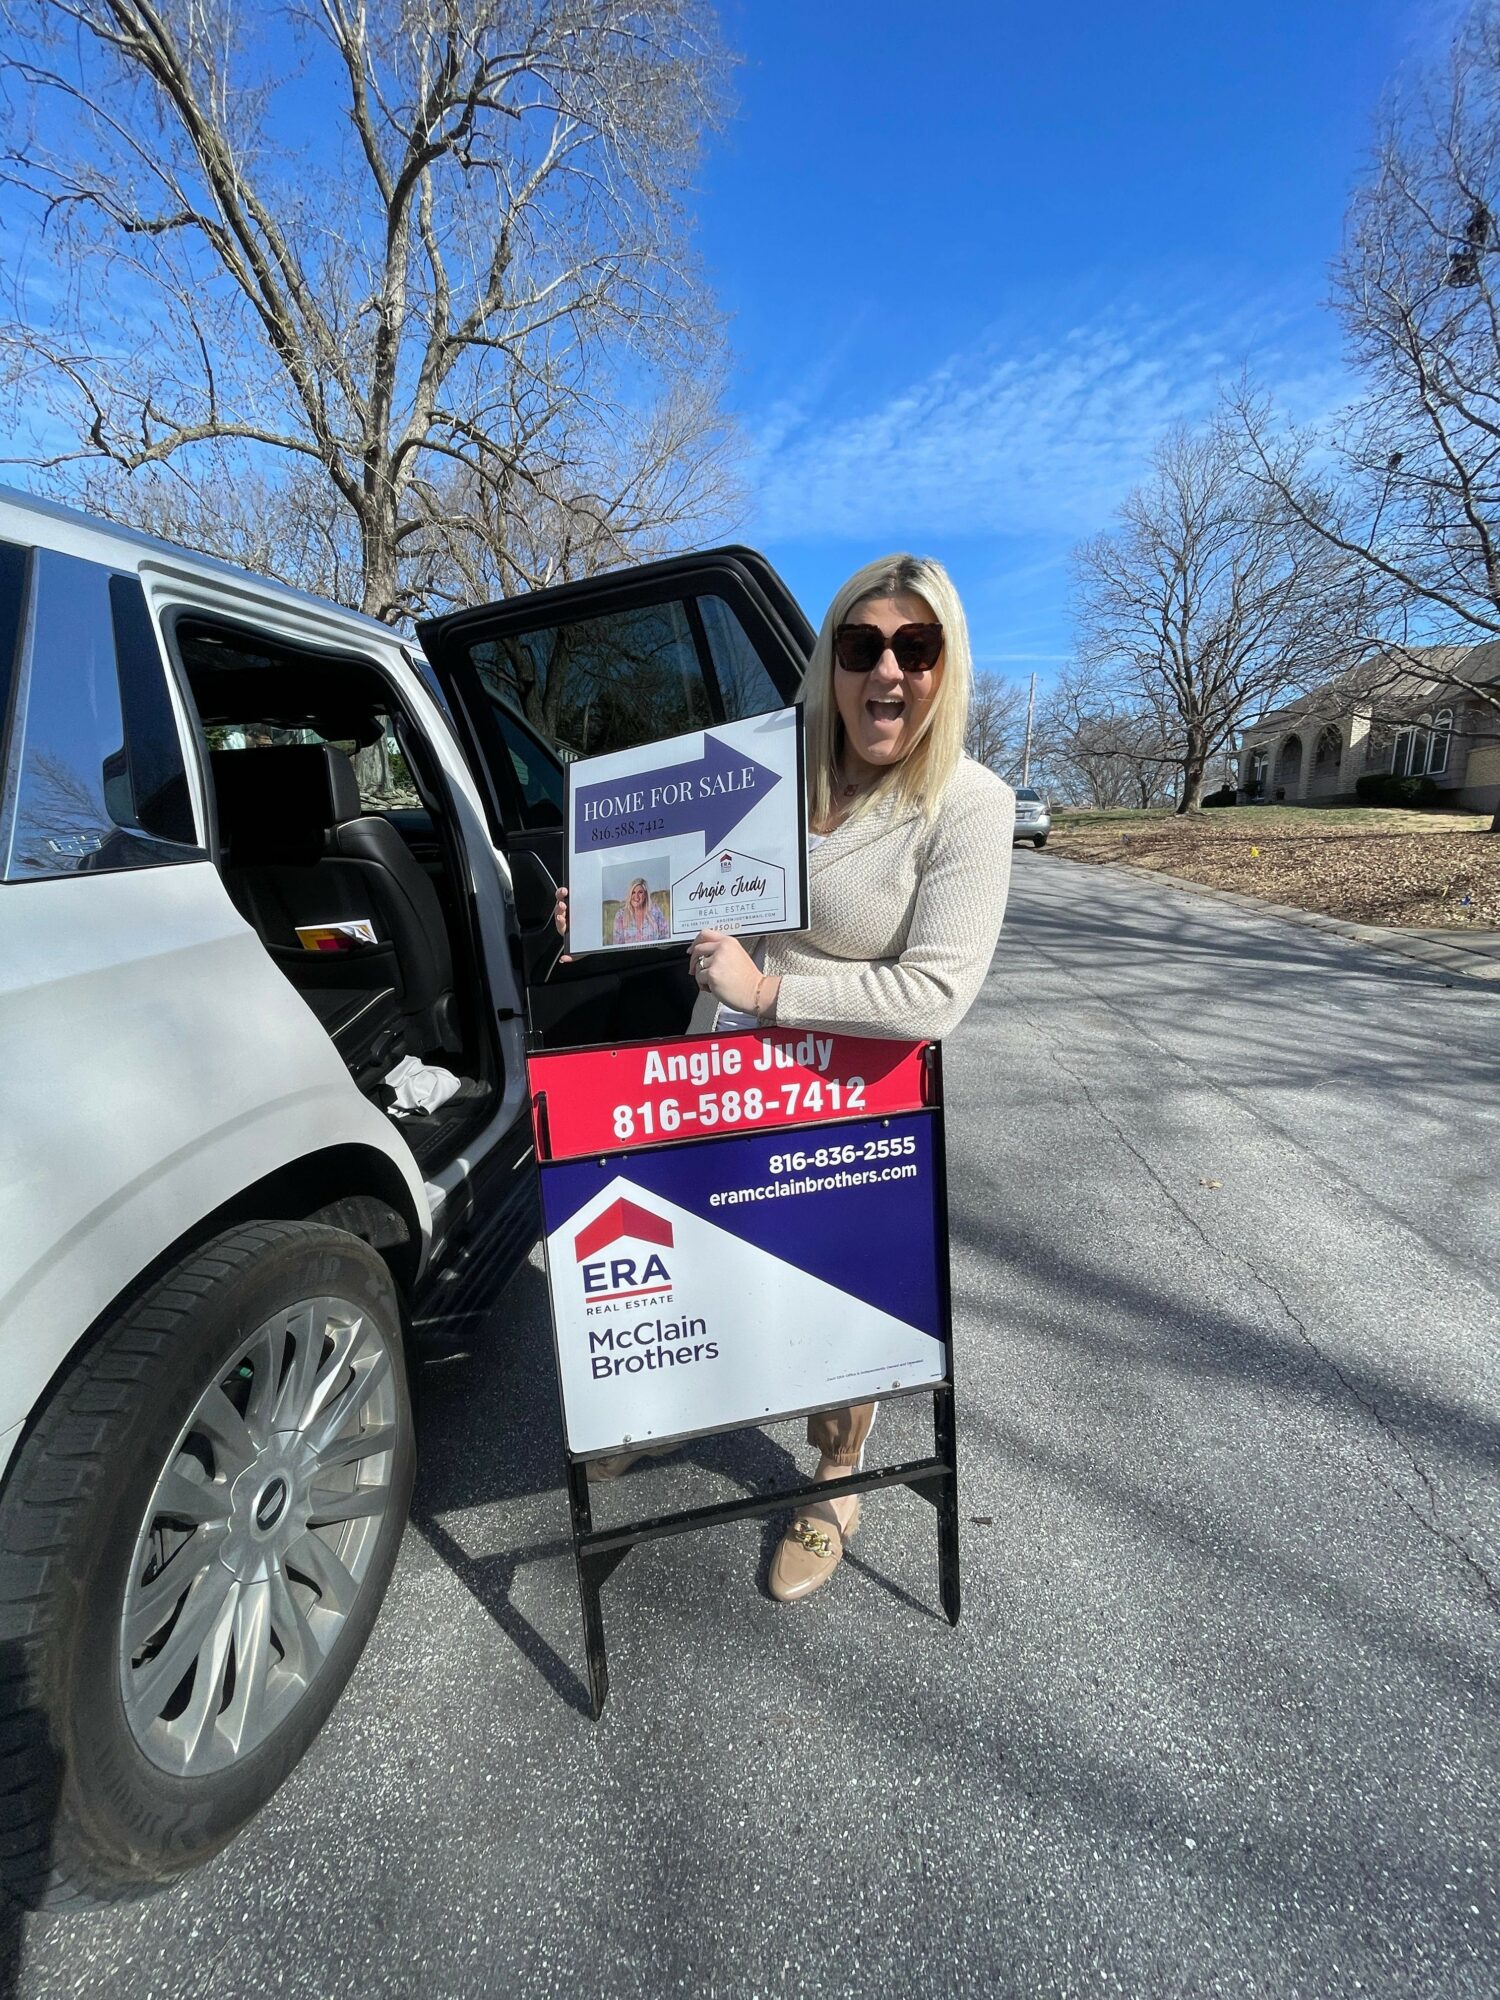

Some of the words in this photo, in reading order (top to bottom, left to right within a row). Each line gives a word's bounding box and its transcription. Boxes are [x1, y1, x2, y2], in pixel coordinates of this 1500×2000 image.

[583, 791, 645, 822] HOME
[650, 781, 694, 808] FOR
[699, 766, 755, 798] SALE
[591, 818, 665, 842] 816.588.7412
[688, 881, 726, 904] Angie
[731, 875, 767, 897] Judy
[698, 907, 719, 916] REAL
[725, 903, 755, 914] ESTATE
[643, 1043, 742, 1086] Angie
[753, 1033, 834, 1072] Judy
[612, 1076, 866, 1140] 816-588-7412
[769, 1135, 916, 1174] 816-836-2555
[709, 1163, 917, 1207] eramcclainbrothers.com
[582, 1254, 671, 1293] ERA
[586, 1303, 620, 1316] REAL
[625, 1294, 674, 1310] ESTATE
[588, 1315, 707, 1354] McClain
[591, 1341, 719, 1380] Brothers
